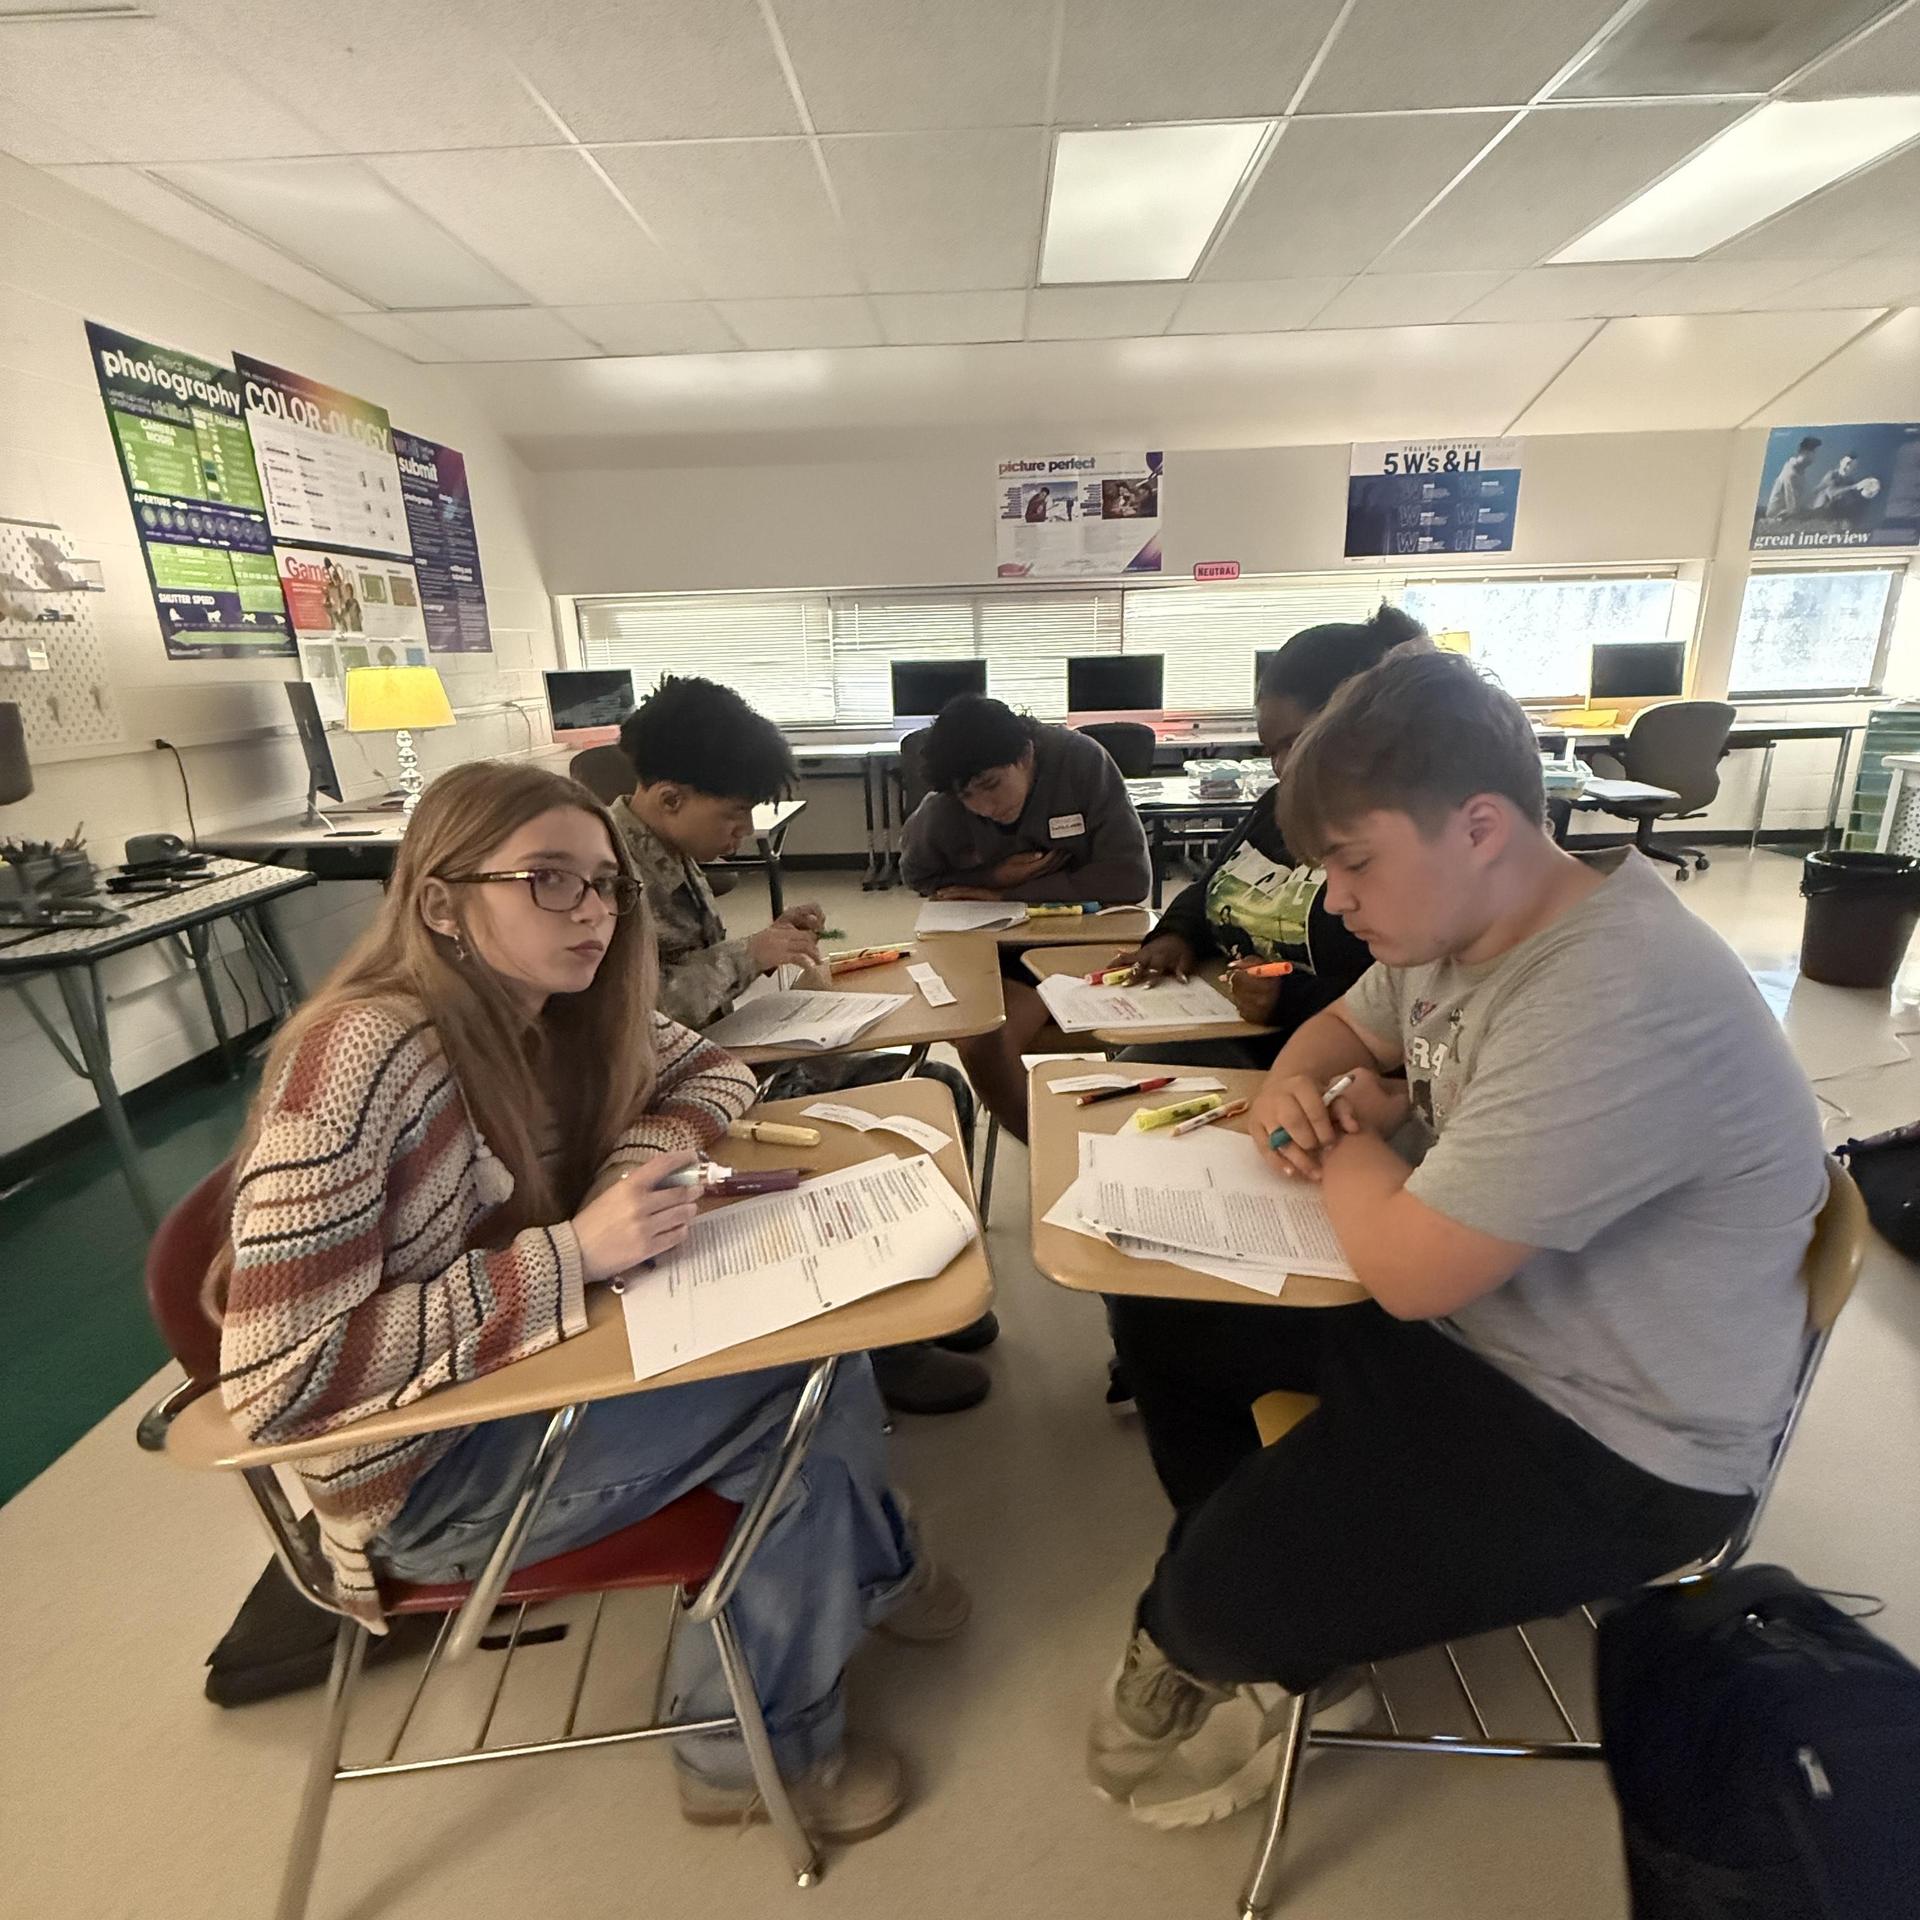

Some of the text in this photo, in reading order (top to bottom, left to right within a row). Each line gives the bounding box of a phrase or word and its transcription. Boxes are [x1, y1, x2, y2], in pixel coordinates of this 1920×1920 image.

[101, 350, 240, 415] photography
[399, 456, 438, 482] submit
[999, 457, 1096, 475] picture perfect
[134, 492, 172, 507] APERTURE
[1753, 529, 1871, 549] great interview
[285, 556, 331, 583] Game
[1197, 566, 1237, 577] NEUTRAL
[158, 592, 215, 605] SHUTTER SPEED
